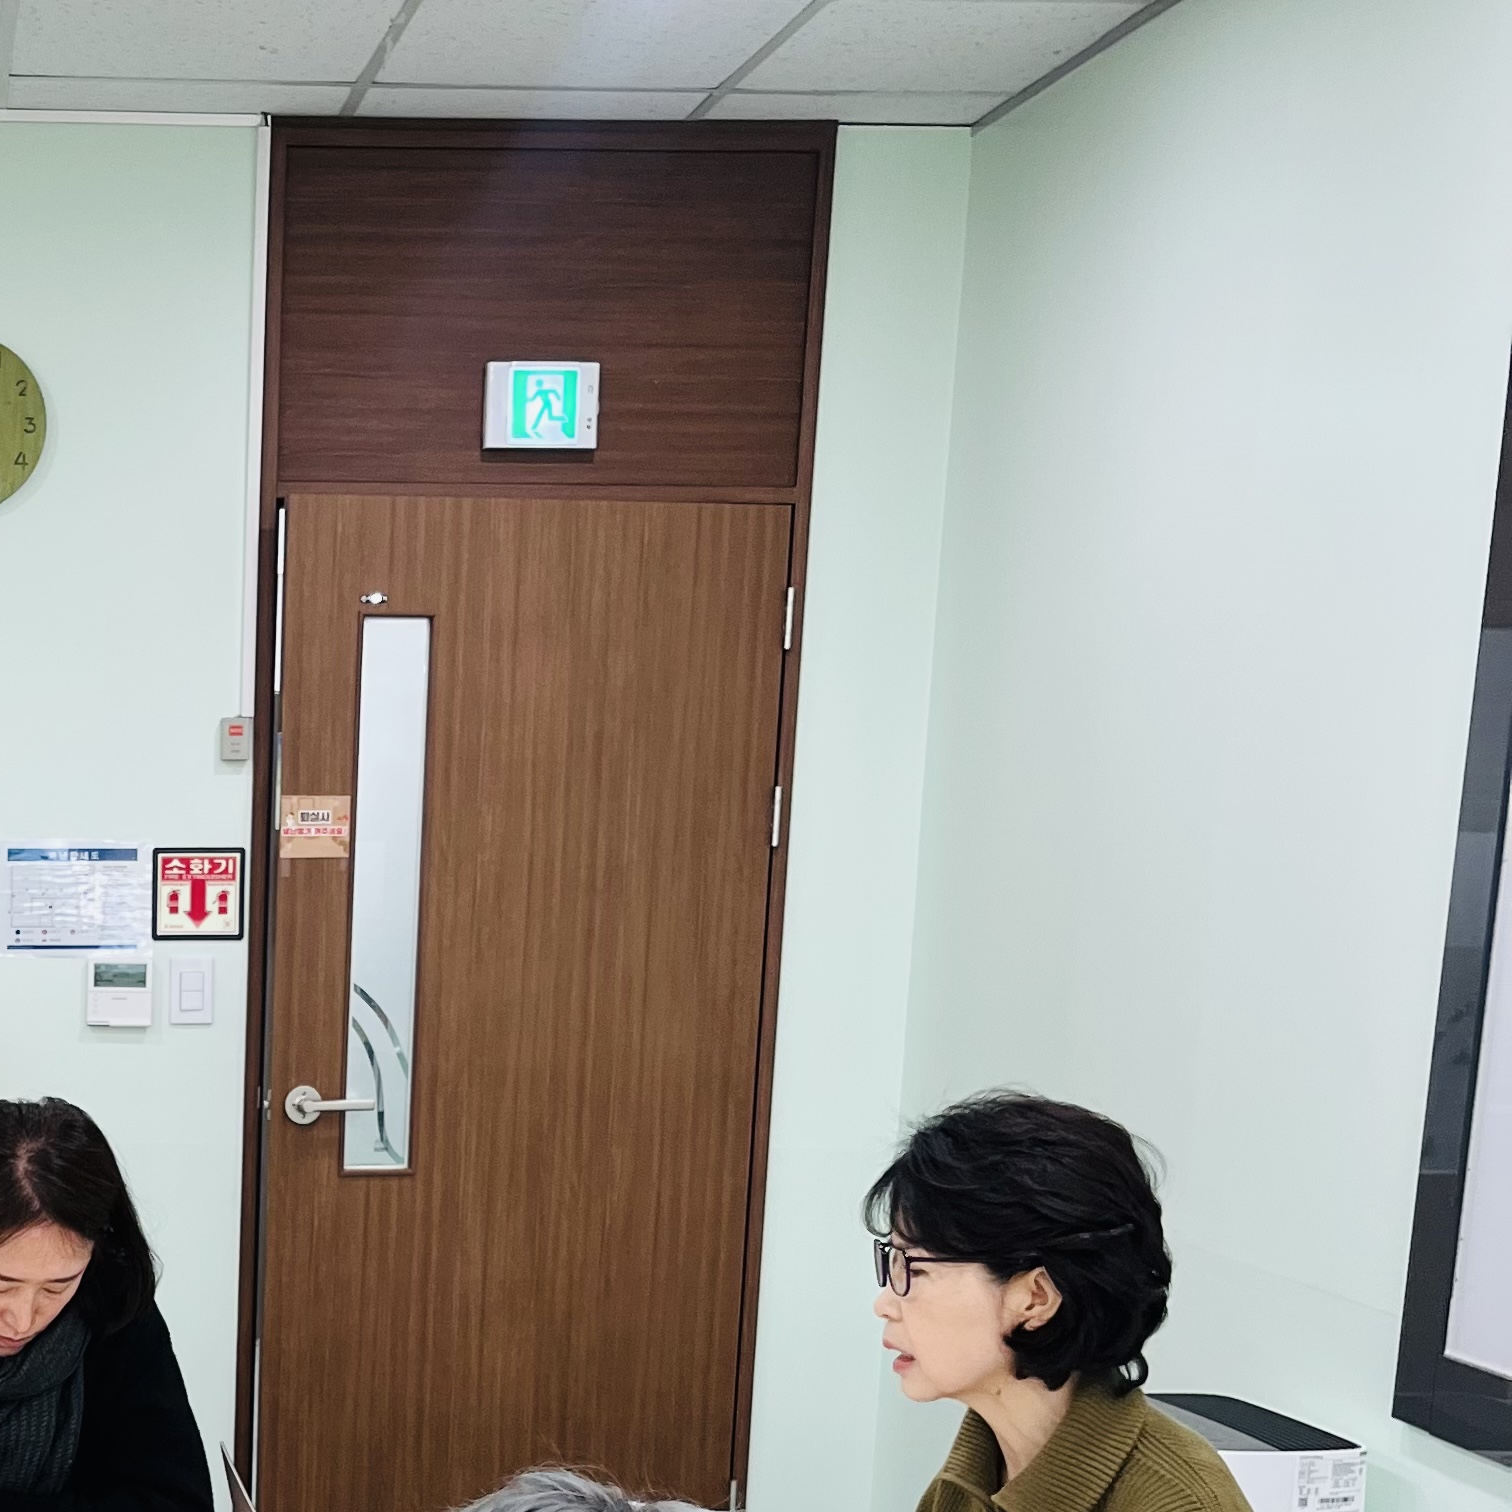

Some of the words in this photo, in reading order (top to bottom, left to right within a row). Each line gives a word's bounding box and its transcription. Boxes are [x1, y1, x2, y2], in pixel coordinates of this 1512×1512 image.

[15, 380, 28, 396] 2
[24, 417, 36, 433] 3
[14, 451, 29, 470] 4
[301, 812, 329, 822] 퇴실시
[164, 859, 234, 875] 소화기
